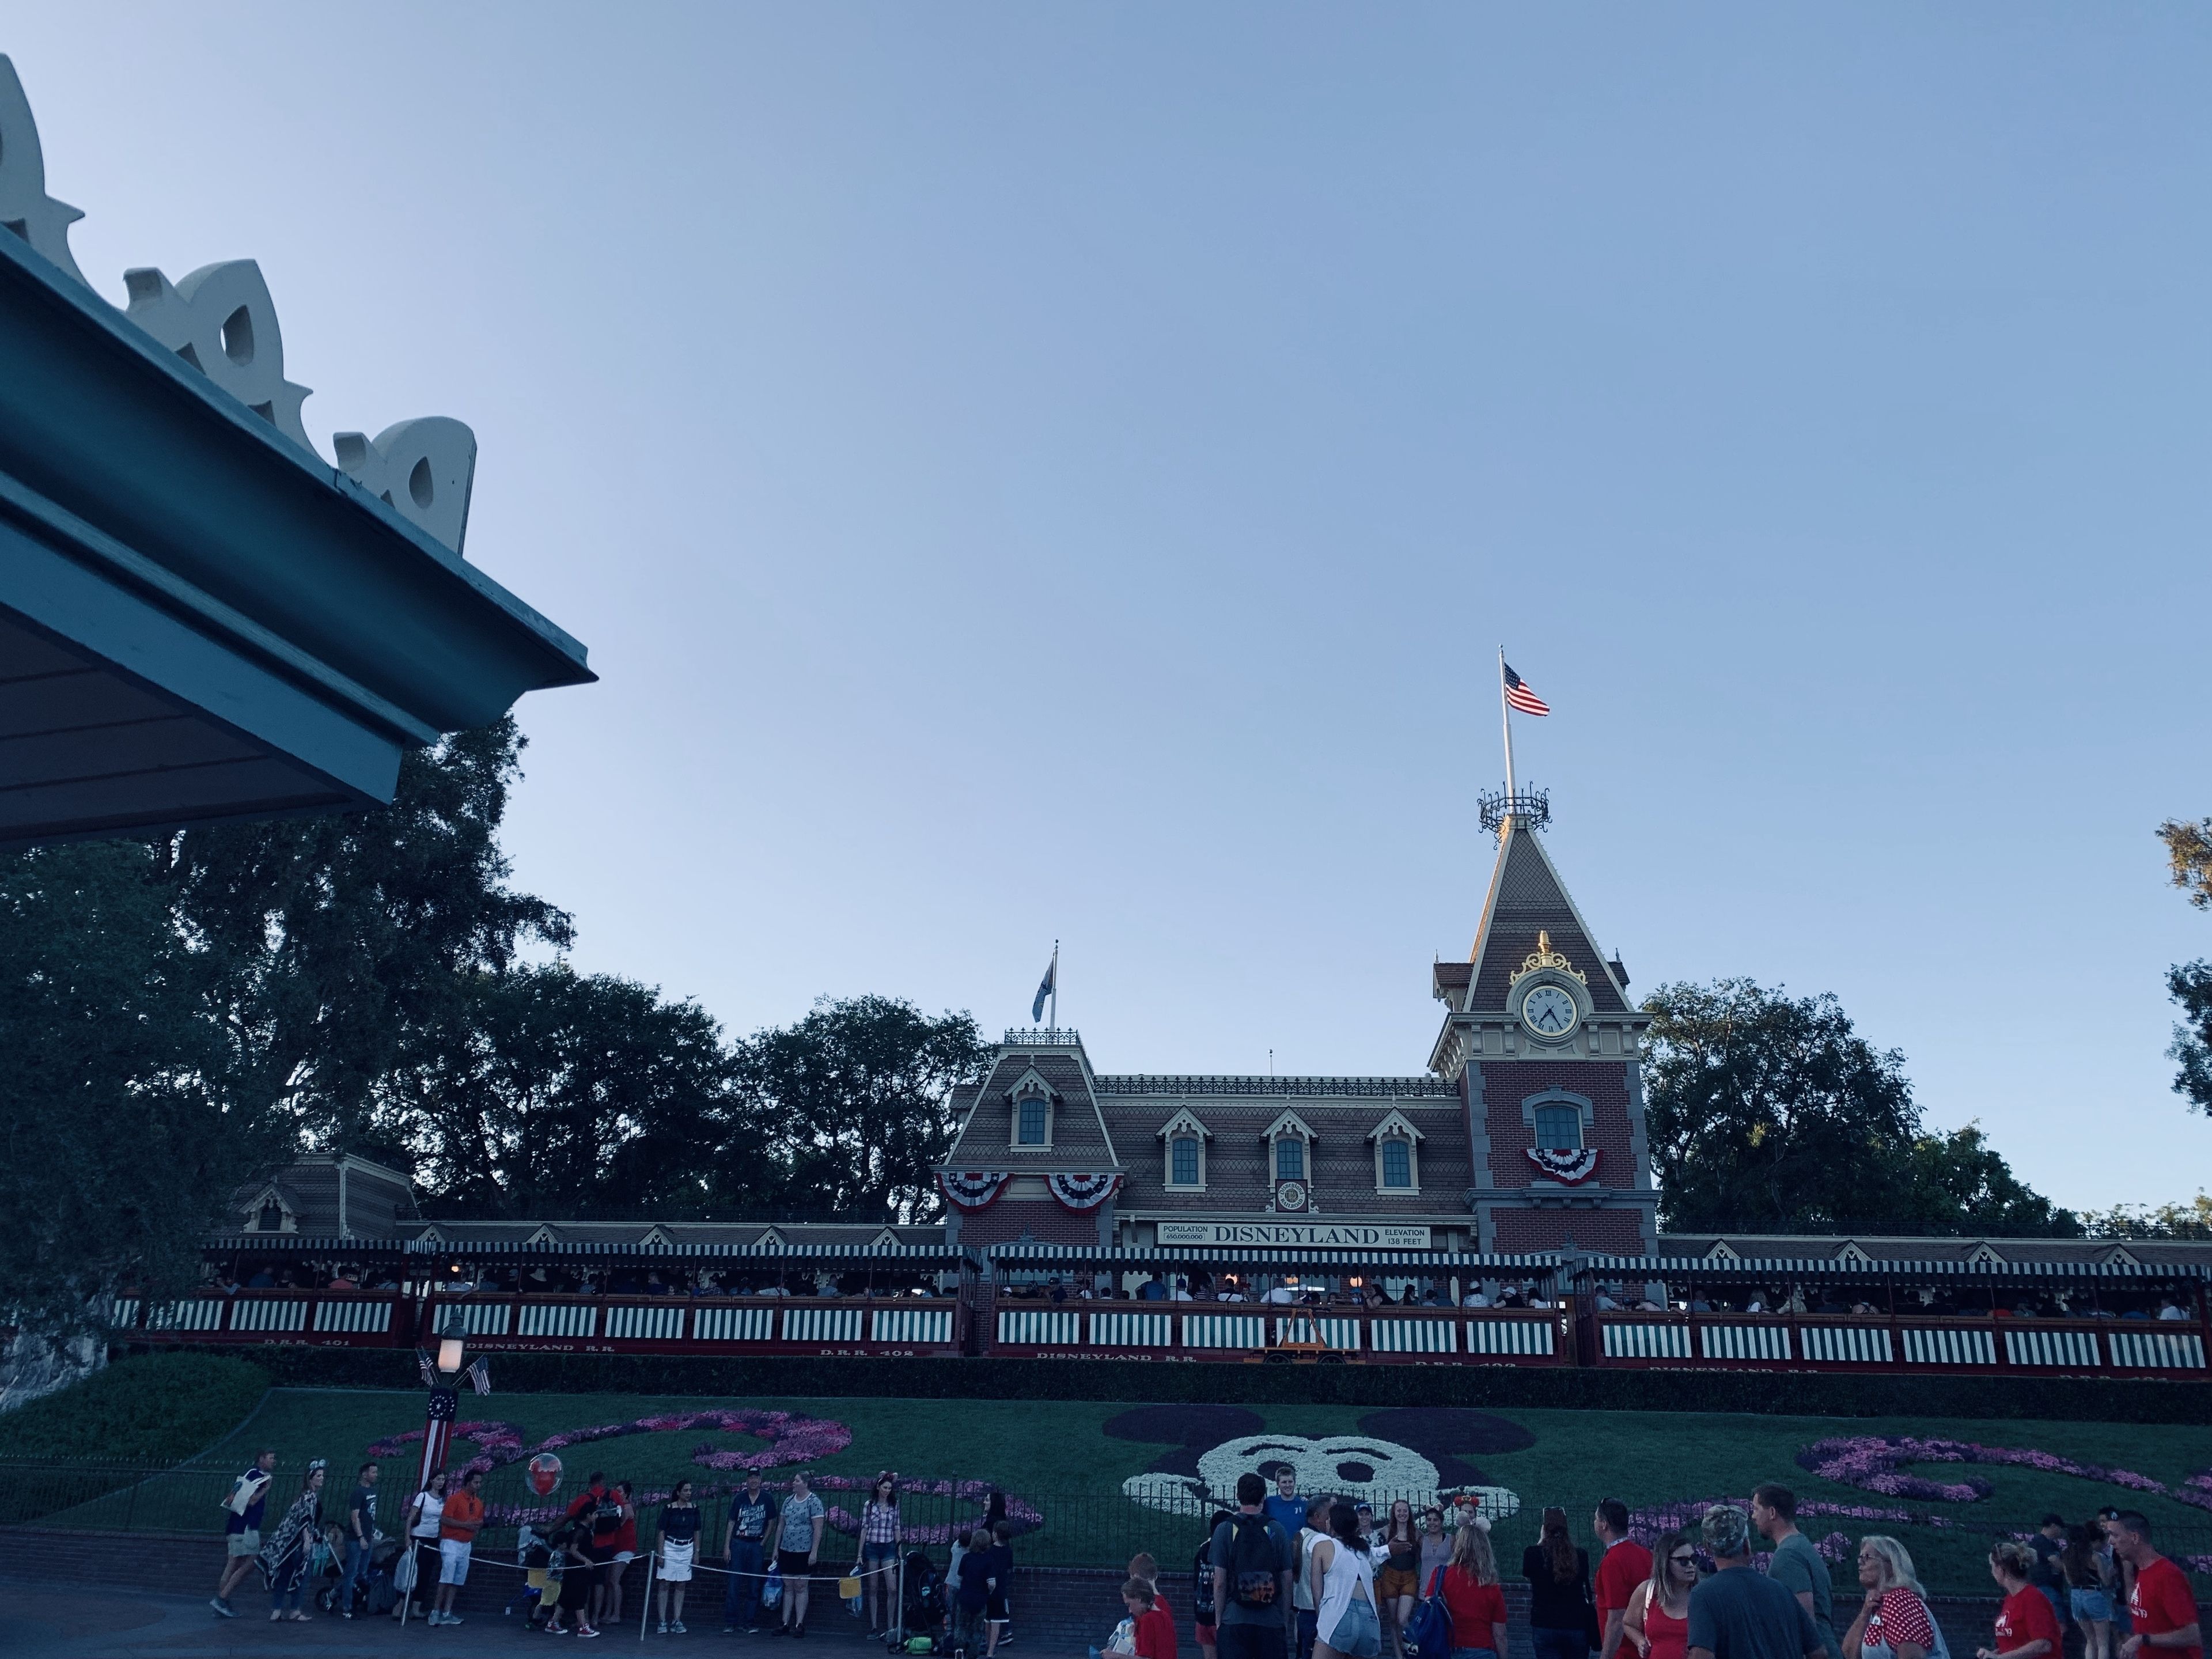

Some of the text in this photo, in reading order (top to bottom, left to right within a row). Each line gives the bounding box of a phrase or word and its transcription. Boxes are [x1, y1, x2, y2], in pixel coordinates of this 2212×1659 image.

[1214, 1226, 1379, 1244] DISNEYLAND
[465, 1343, 574, 1351] DISNEYLAND
[1037, 1353, 1152, 1361] DISNEYLAND
